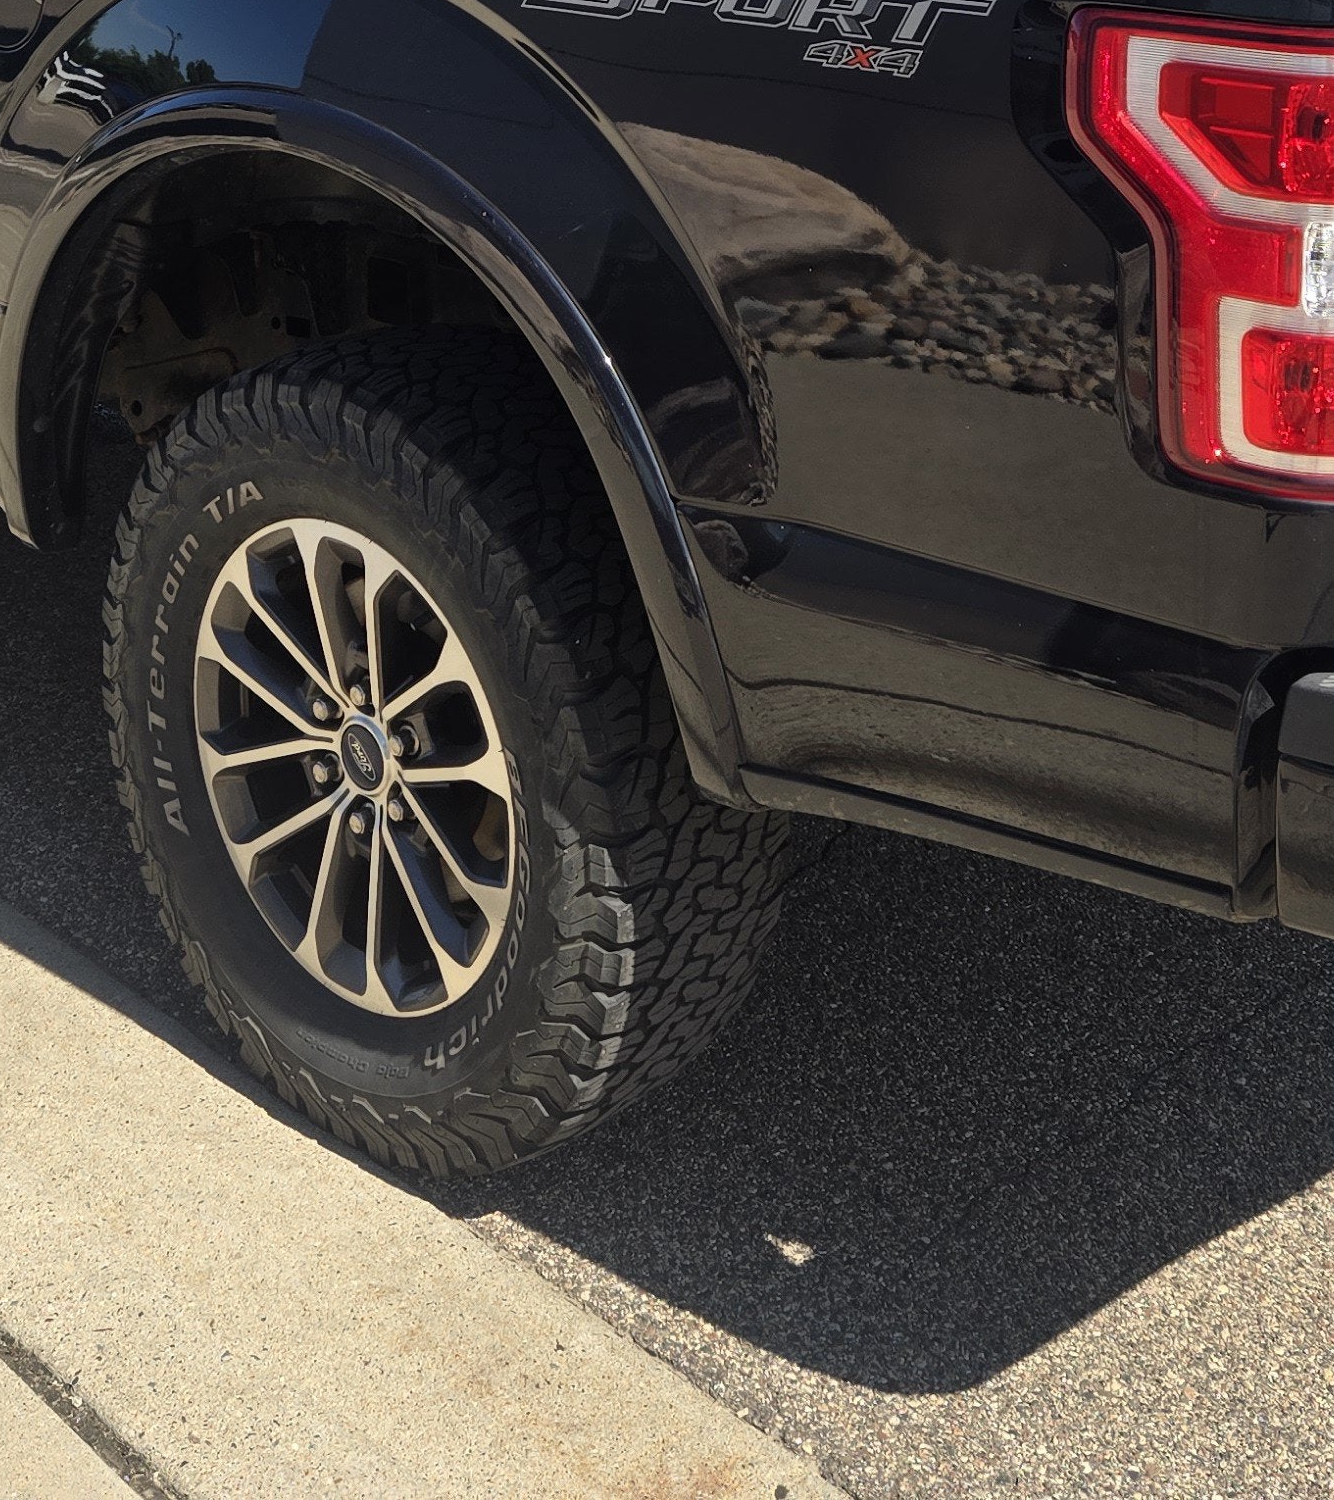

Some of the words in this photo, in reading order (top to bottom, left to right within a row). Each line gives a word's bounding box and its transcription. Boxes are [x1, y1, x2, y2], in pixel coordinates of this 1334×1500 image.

[147, 533, 200, 837] All-Terrain
[202, 480, 264, 525] T/A
[351, 740, 372, 772] Ford
[424, 748, 530, 1070] BFGoodrich
